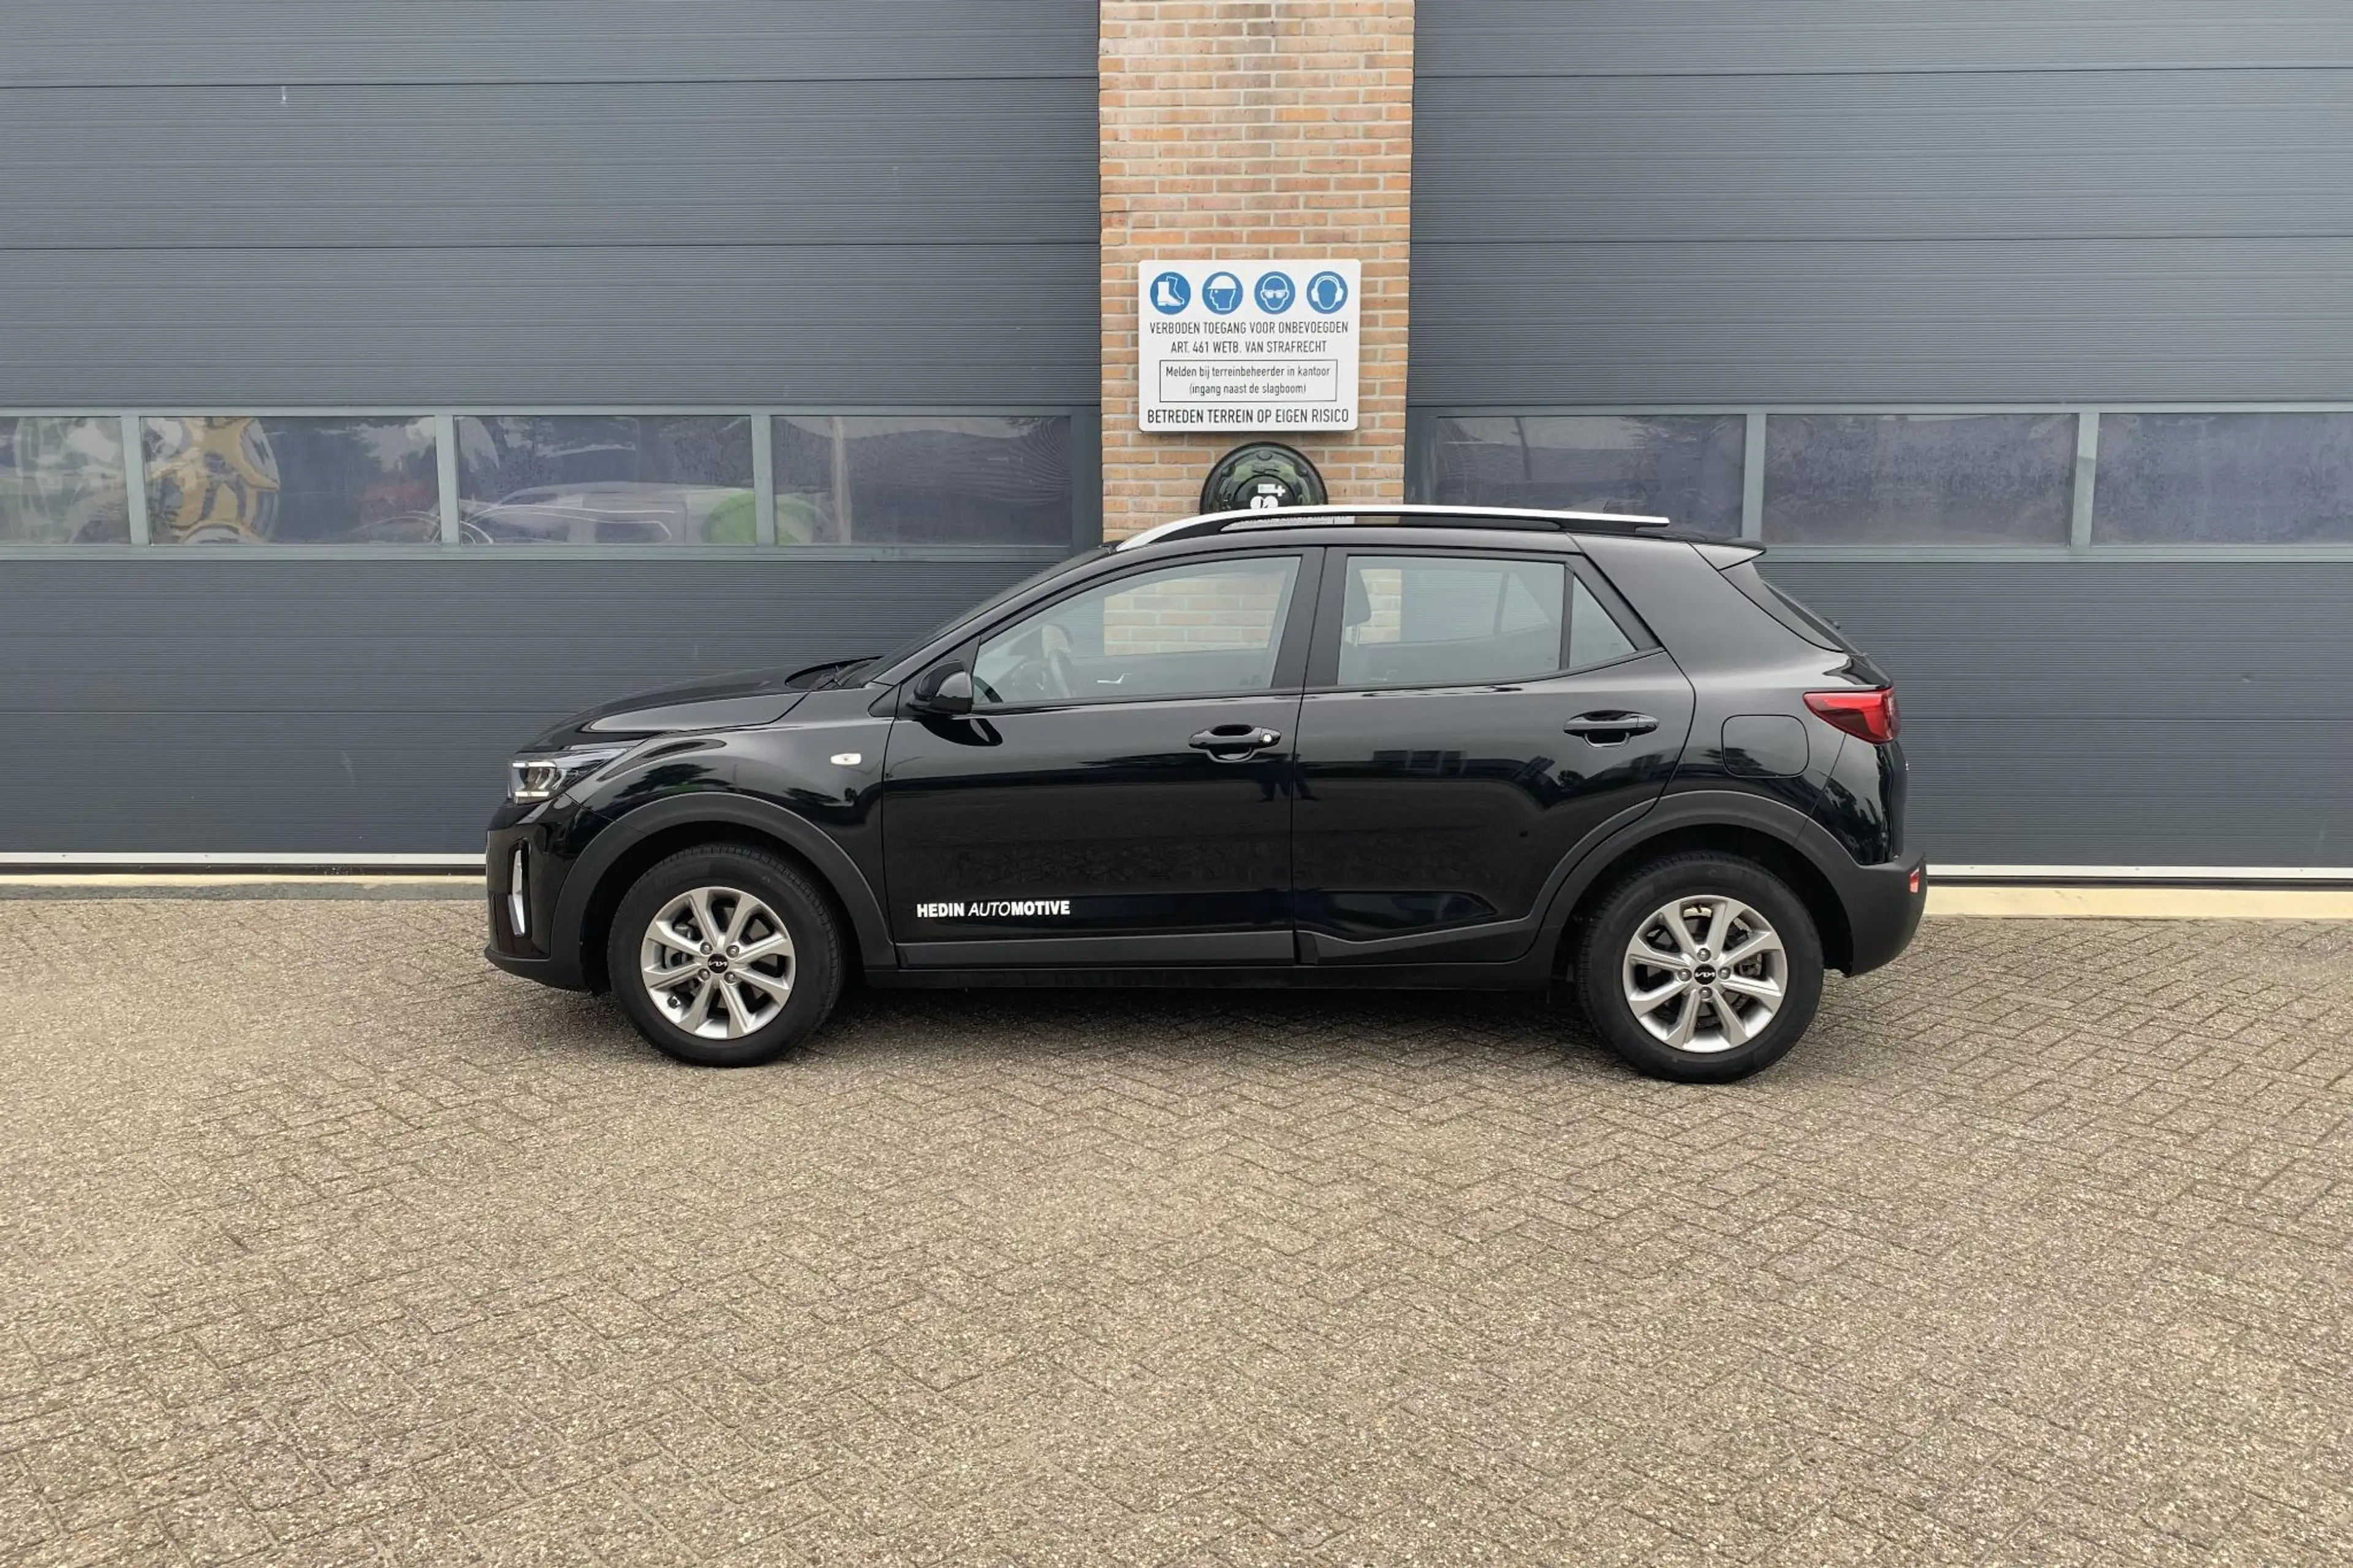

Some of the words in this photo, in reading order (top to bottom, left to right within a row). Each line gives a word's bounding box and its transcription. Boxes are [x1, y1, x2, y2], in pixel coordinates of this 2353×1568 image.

[1150, 322, 1200, 334] VERBODEN
[1203, 322, 1246, 334] TOEGANG
[1249, 322, 1275, 334] VOOR
[1278, 321, 1349, 333] ONBEVOEGDEN
[1170, 341, 1189, 354] ART.
[1192, 341, 1209, 353] 461
[1213, 341, 1241, 354] WETB.
[1245, 341, 1264, 353] VAN
[1267, 340, 1327, 353] STRAFRECHT
[1165, 366, 1197, 377] Melden
[1199, 366, 1210, 379] bij
[1212, 366, 1285, 377] terreinbeheerder
[1287, 365, 1295, 376] in
[1298, 365, 1330, 376] kantoor
[1189, 384, 1221, 396] (ingang
[1223, 384, 1246, 394] naast
[1249, 383, 1260, 394] de
[1262, 382, 1306, 396] slagboom)
[1147, 409, 1203, 423] BETREDEN
[1207, 409, 1253, 423] TERREIN
[1257, 408, 1272, 423] OP
[1275, 408, 1308, 423] EIGEN
[1312, 408, 1349, 423] RISICO
[917, 903, 965, 918] HEDIN
[968, 900, 1070, 917] AUTOMOTIVE
